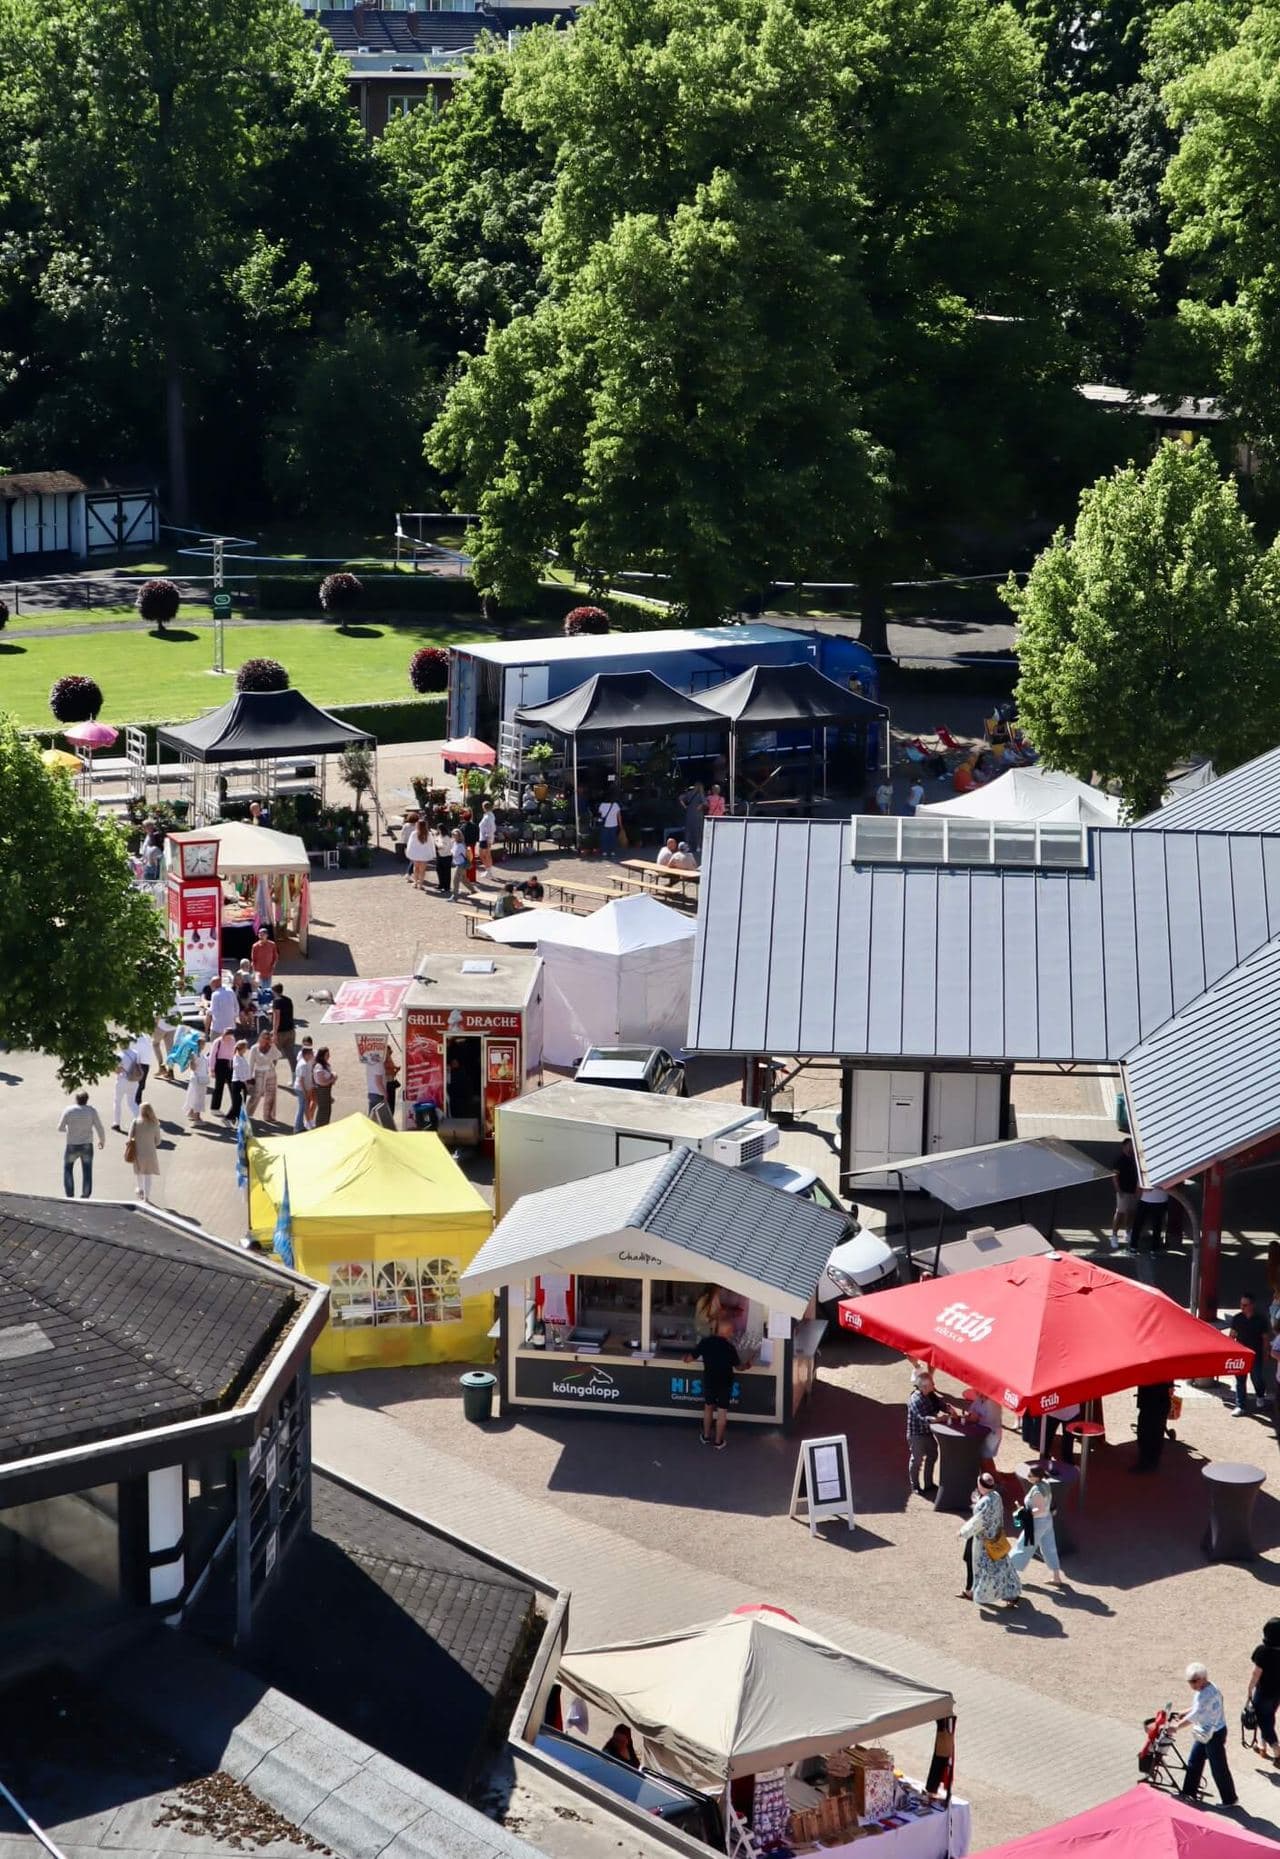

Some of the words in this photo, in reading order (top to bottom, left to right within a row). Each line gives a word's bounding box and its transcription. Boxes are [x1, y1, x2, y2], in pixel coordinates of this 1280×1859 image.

[407, 1014, 445, 1026] GRILL
[466, 1016, 518, 1028] DRACHE
[845, 1310, 862, 1328] früh
[936, 1302, 996, 1343] früh
[1224, 1358, 1245, 1370] früh
[552, 1382, 620, 1399] kölngalopp
[1040, 1392, 1059, 1409] früh
